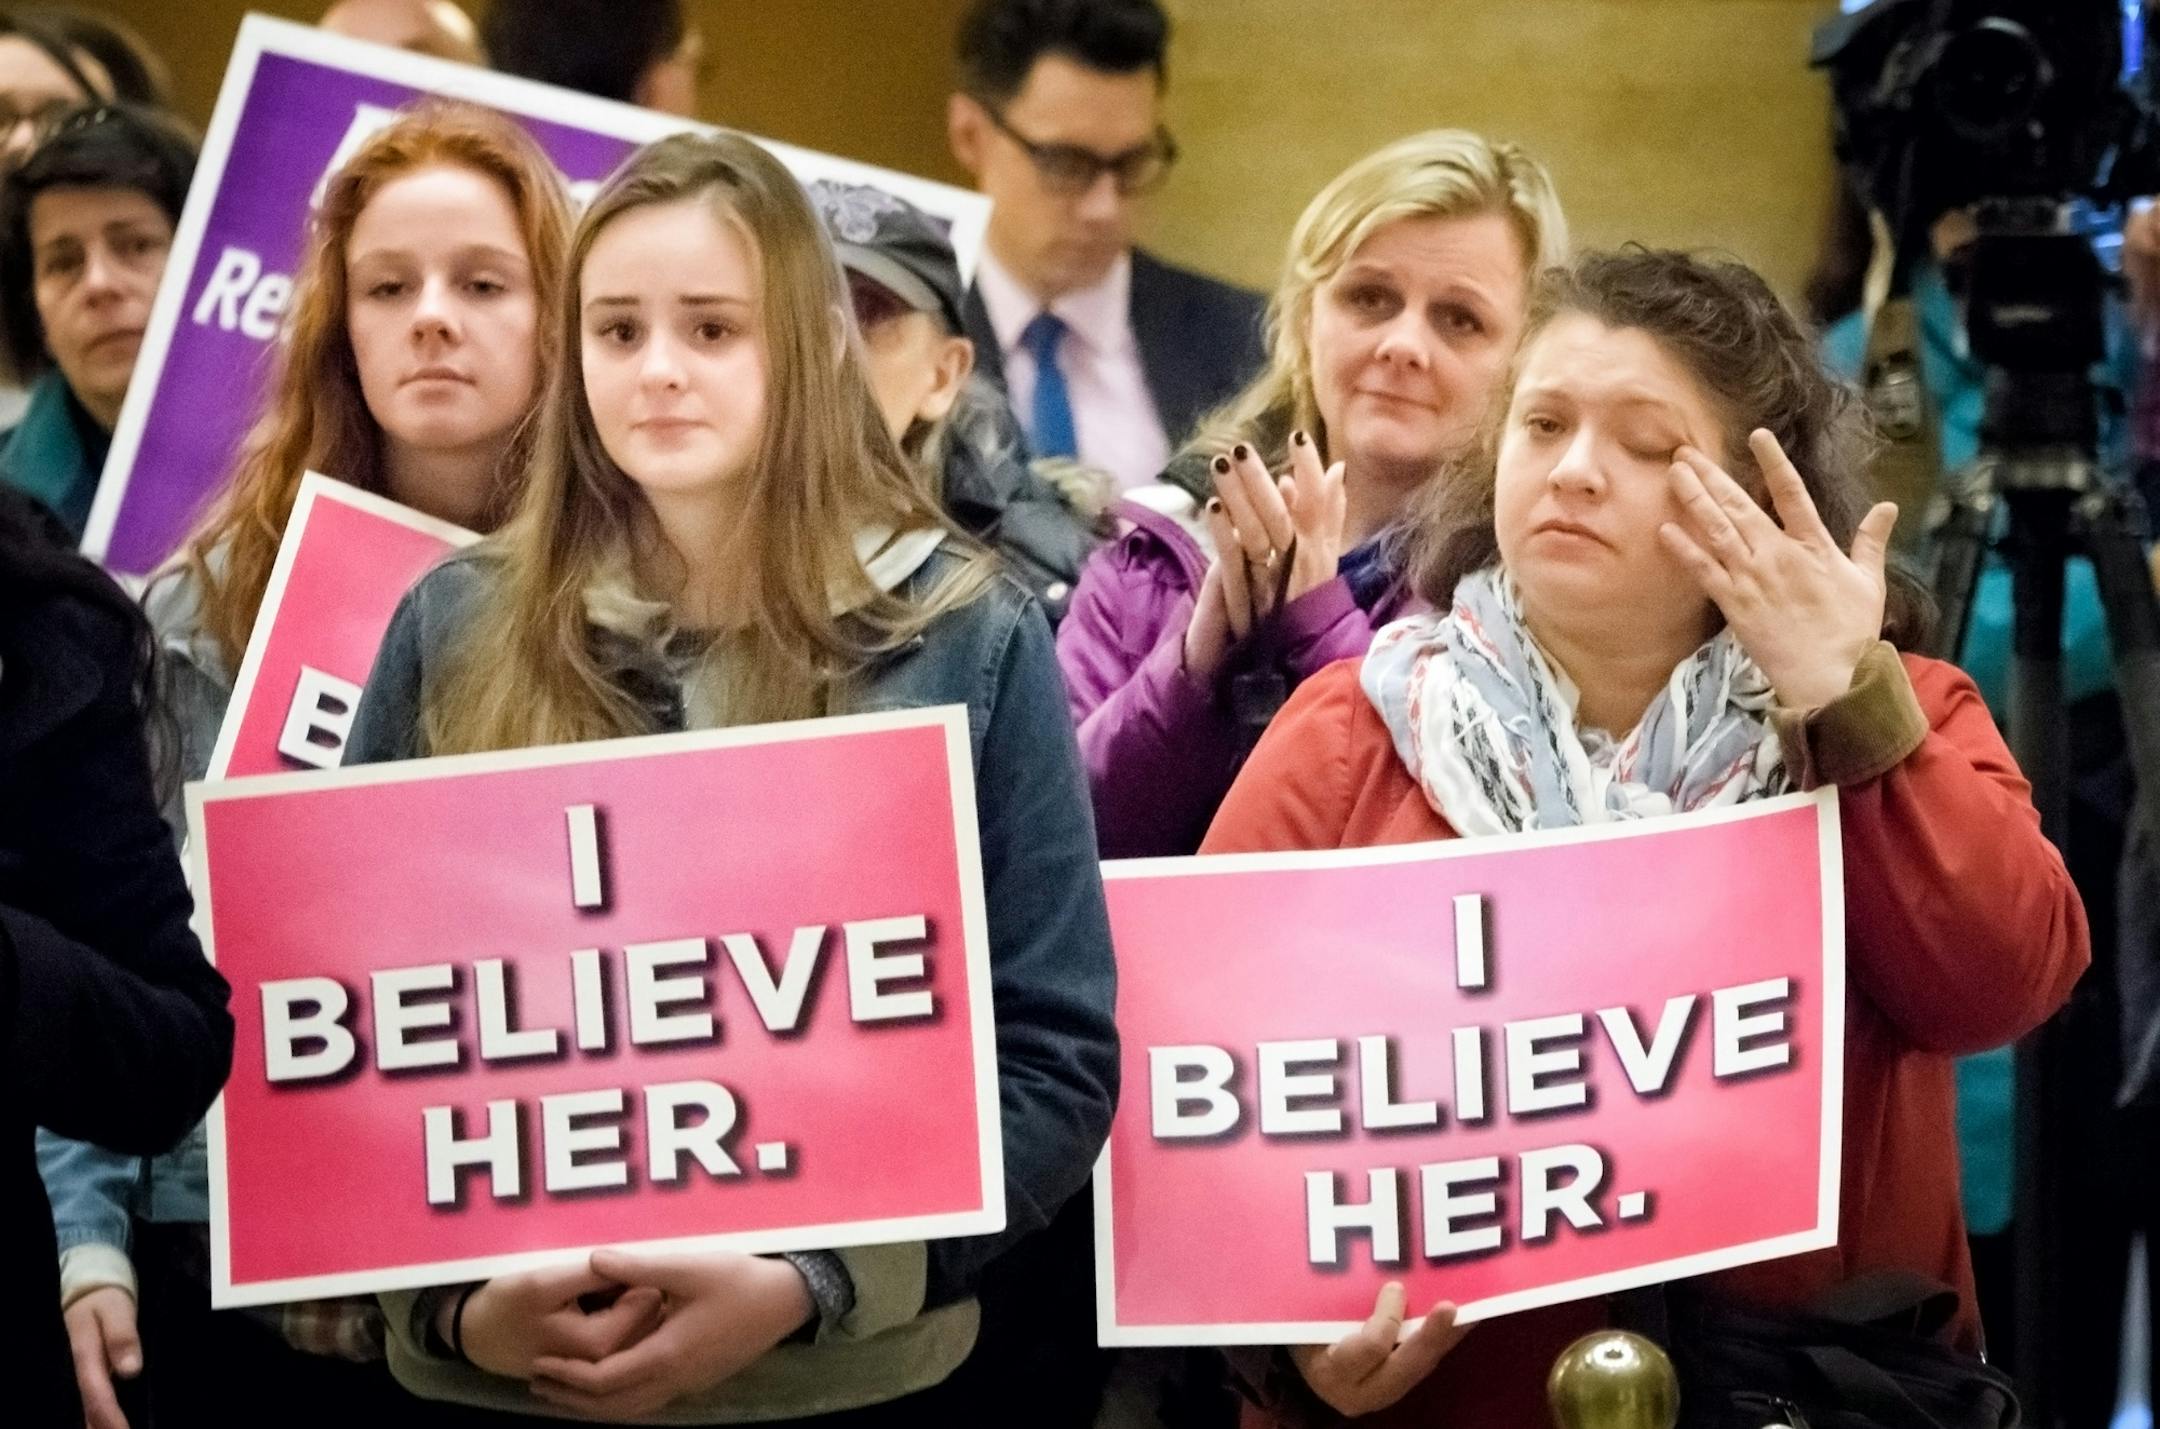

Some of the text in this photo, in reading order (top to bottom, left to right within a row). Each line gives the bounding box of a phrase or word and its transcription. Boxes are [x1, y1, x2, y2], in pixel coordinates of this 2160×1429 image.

[563, 803, 603, 907] I
[257, 913, 936, 1084] BELIEVE
[1450, 892, 1487, 988] I
[1147, 975, 1793, 1138] BELIEVE
[421, 1078, 789, 1206] HER.
[1303, 1142, 1647, 1264] HER.
